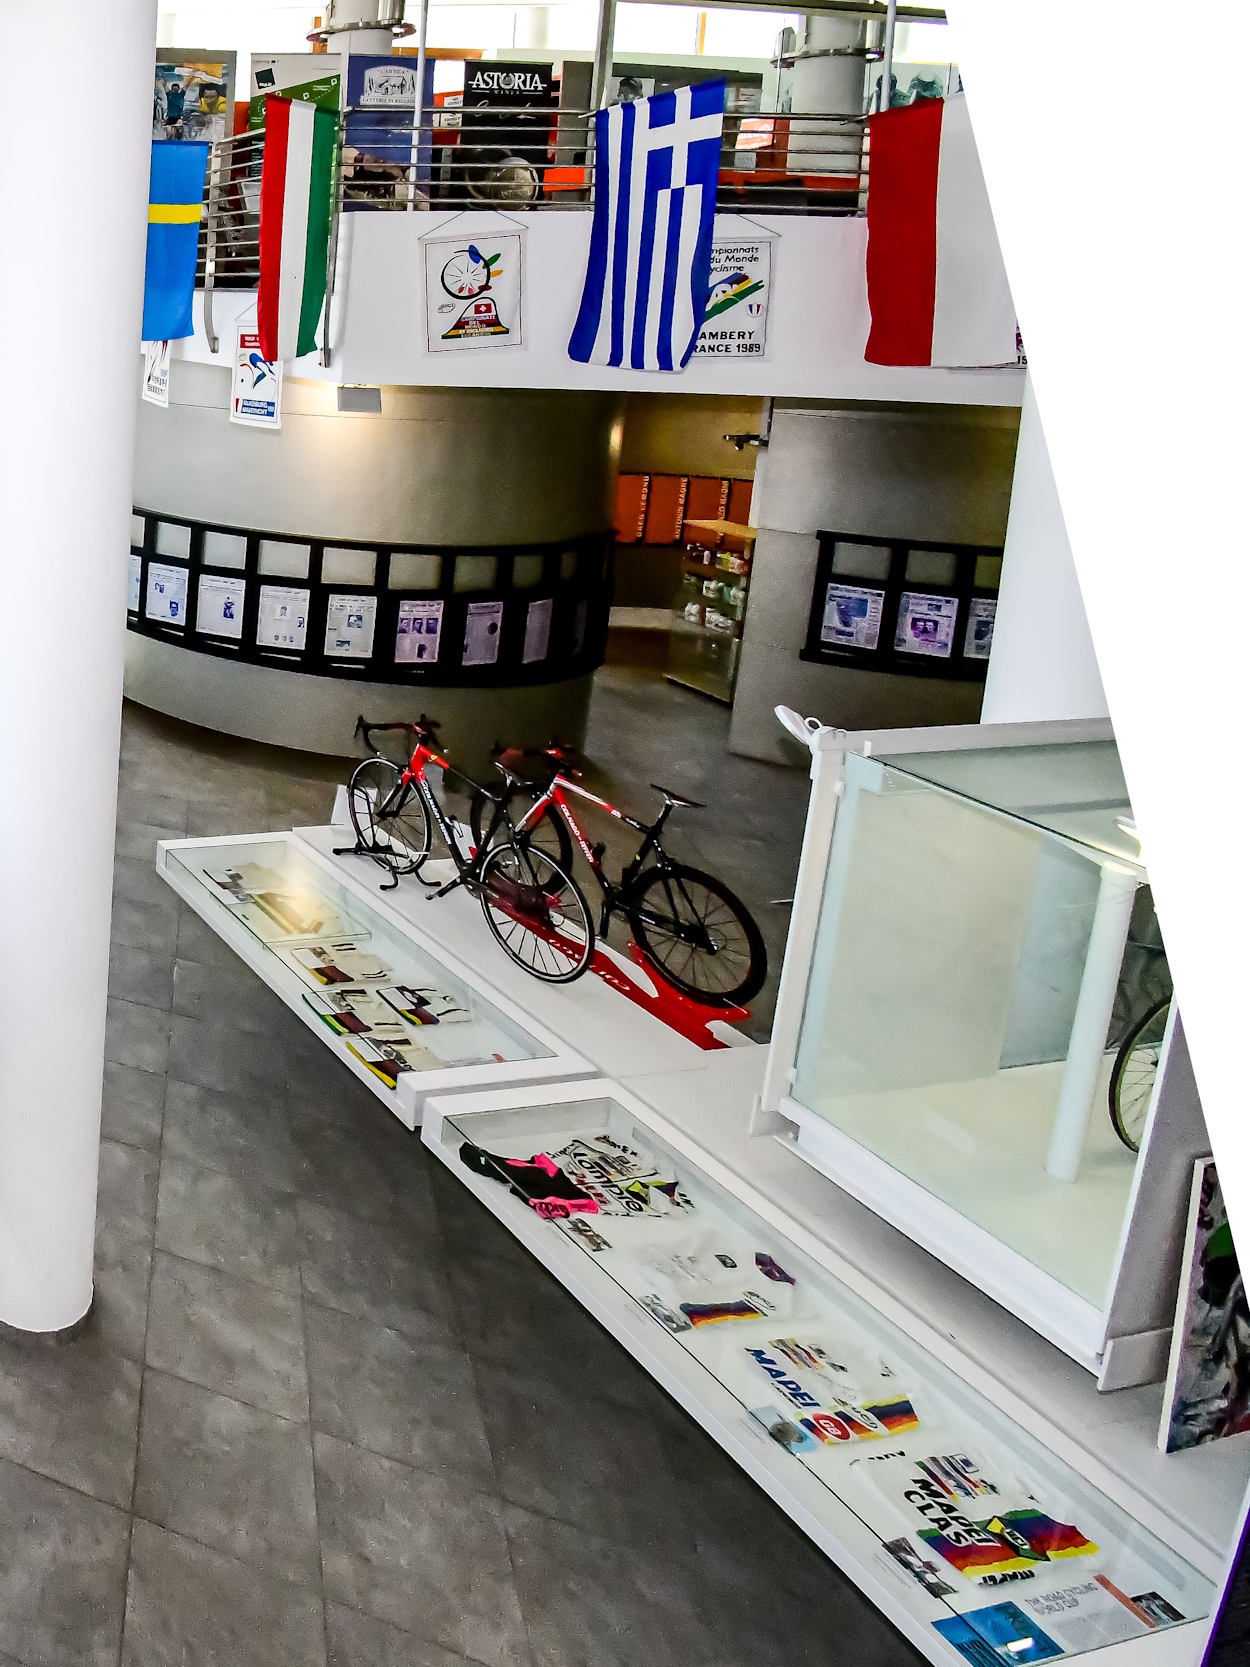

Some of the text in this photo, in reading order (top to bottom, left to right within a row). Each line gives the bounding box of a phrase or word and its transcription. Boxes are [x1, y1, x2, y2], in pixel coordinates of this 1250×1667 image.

[468, 71, 547, 91] ASTORIA
[724, 254, 759, 263] Monde
[699, 330, 755, 340] AMBERY
[694, 343, 761, 353] RANCE 1989
[744, 1347, 821, 1409] MAPEI
[903, 1489, 970, 1548] CLAS
[910, 1477, 1001, 1548] MAPEI
